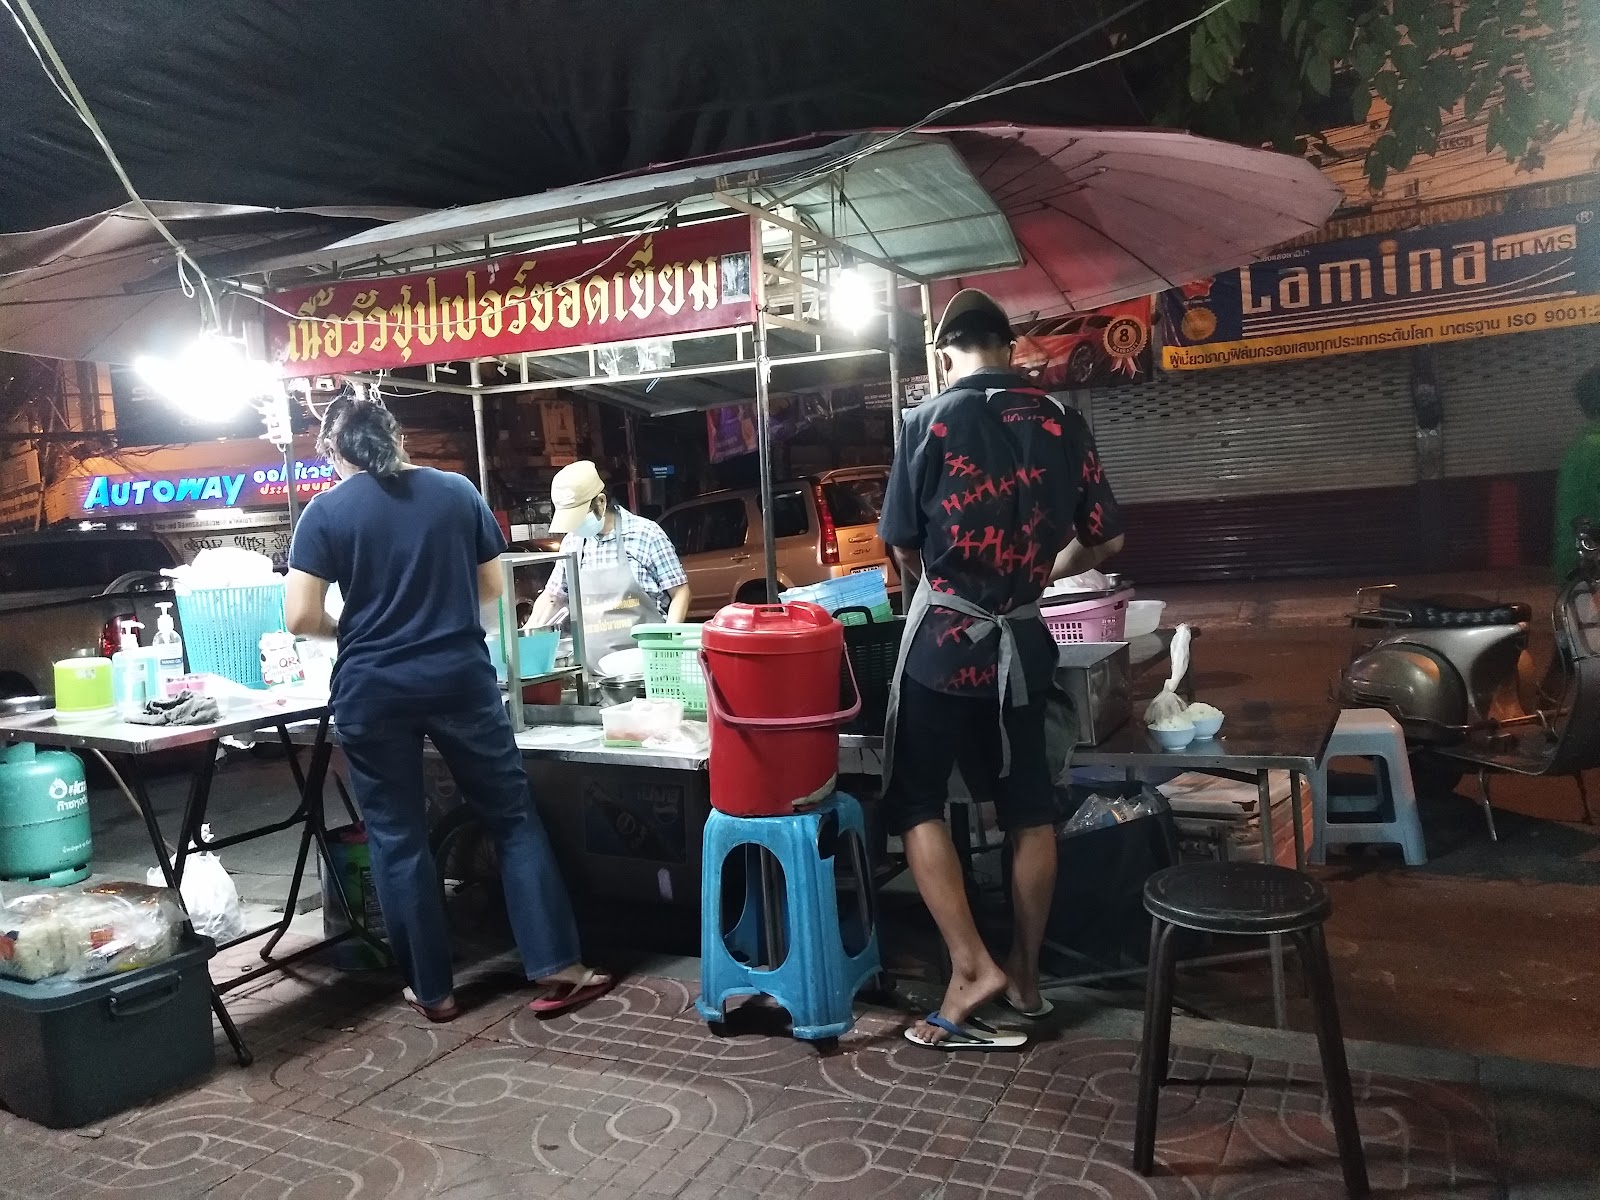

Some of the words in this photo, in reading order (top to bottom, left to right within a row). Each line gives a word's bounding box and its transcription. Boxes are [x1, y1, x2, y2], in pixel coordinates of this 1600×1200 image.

[1239, 240, 1487, 315] Lamina
[1507, 312, 1537, 328] ISO
[1120, 328, 1130, 342] 8
[83, 473, 246, 509] AUTOWAY
